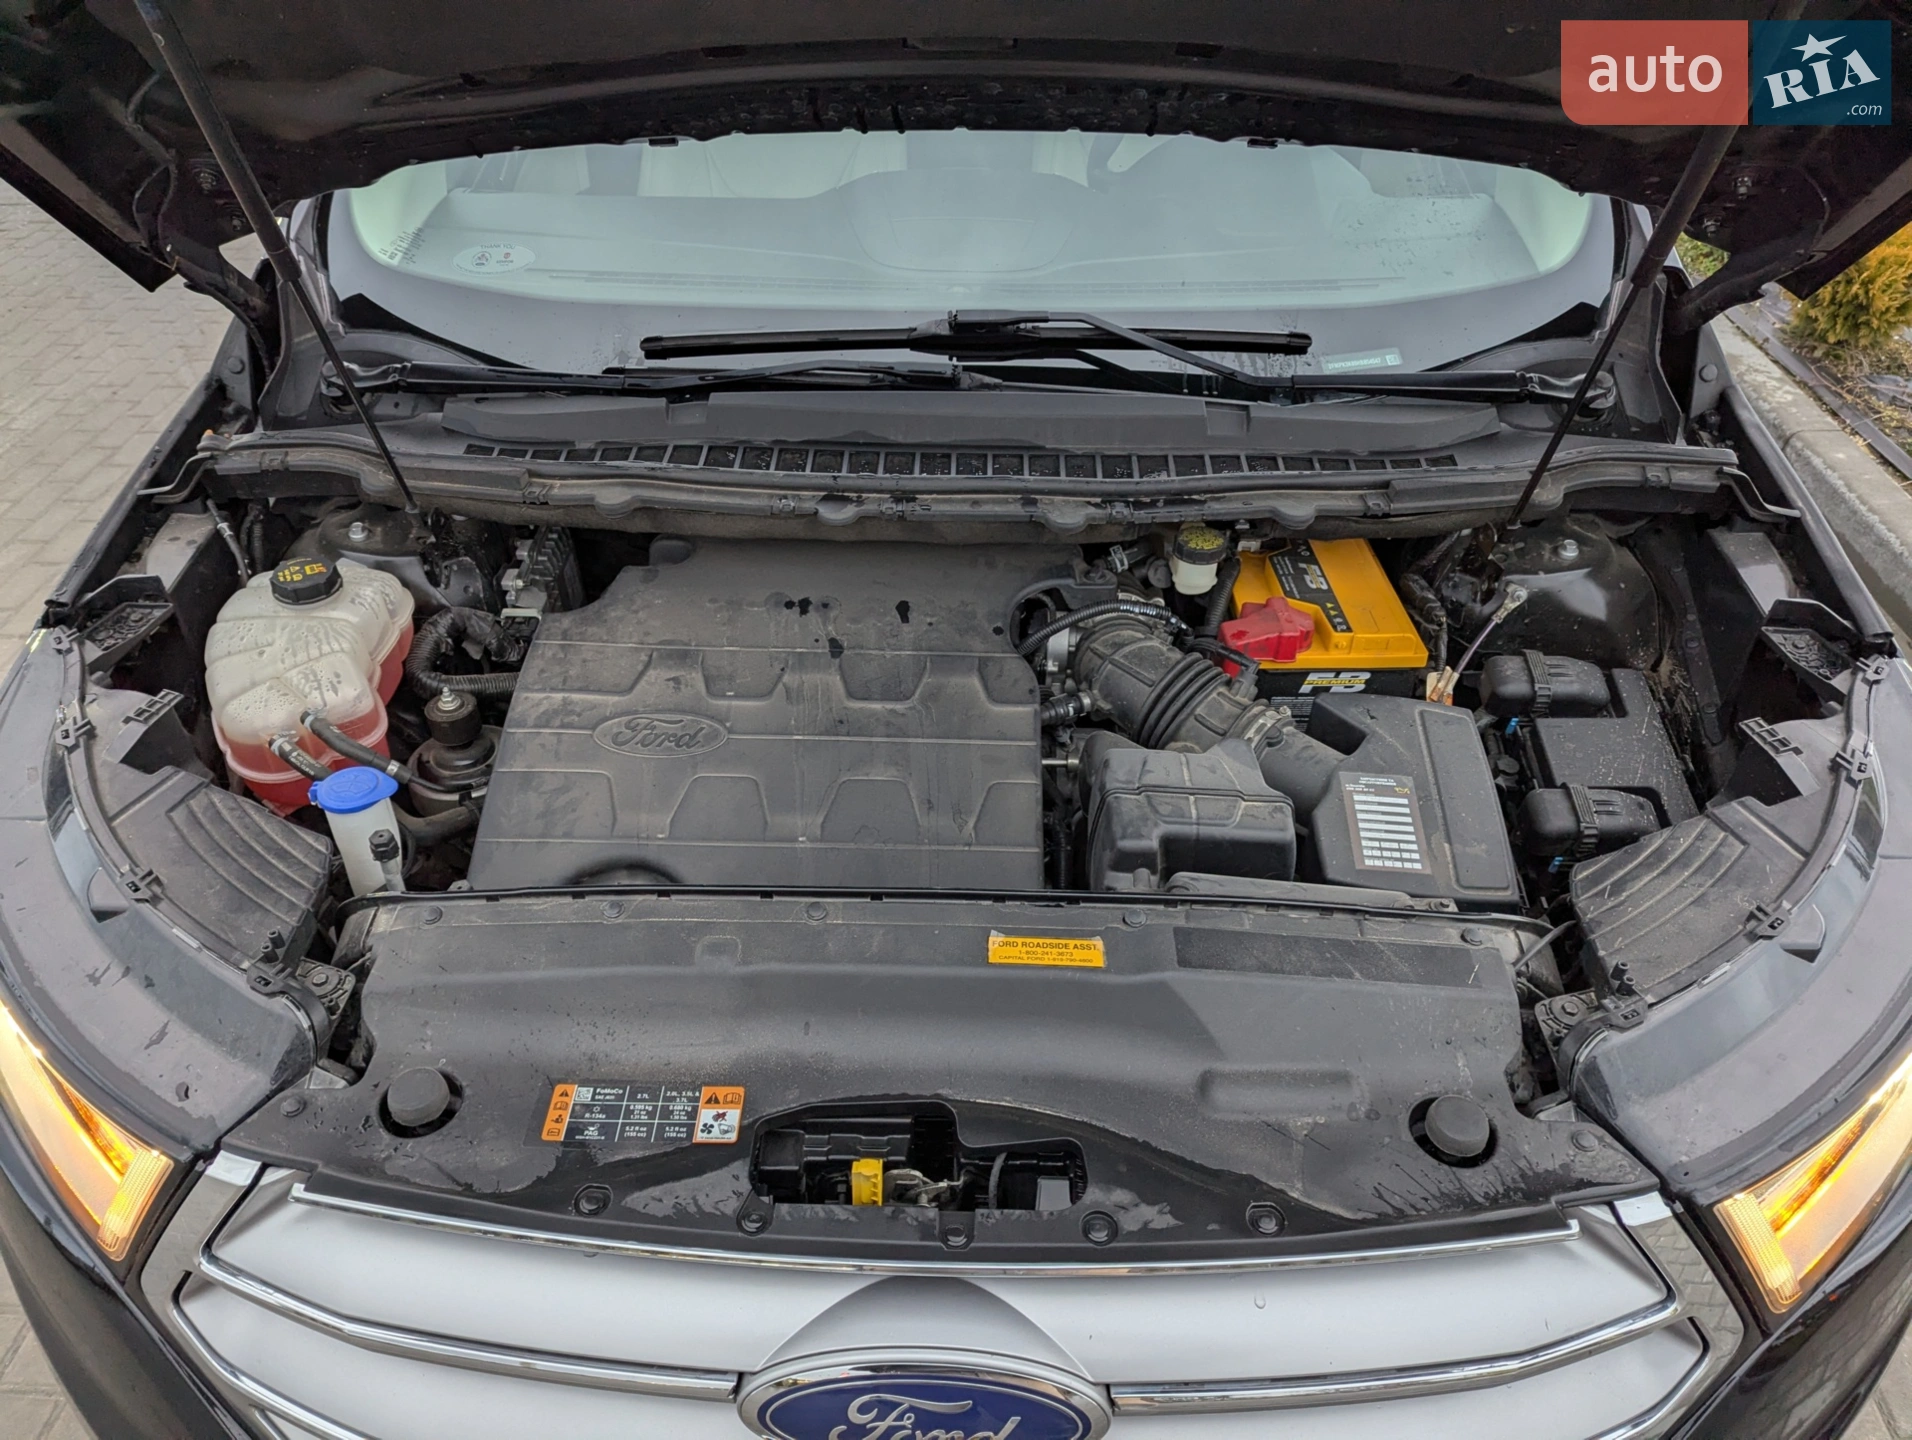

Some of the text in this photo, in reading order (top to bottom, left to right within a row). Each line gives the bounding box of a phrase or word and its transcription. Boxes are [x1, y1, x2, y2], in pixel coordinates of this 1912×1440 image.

[611, 716, 706, 749] Ford
[1021, 941, 1071, 950] ROADSIDE
[1072, 943, 1100, 951] ASST.
[1018, 950, 1074, 958] 1-800-241-3673
